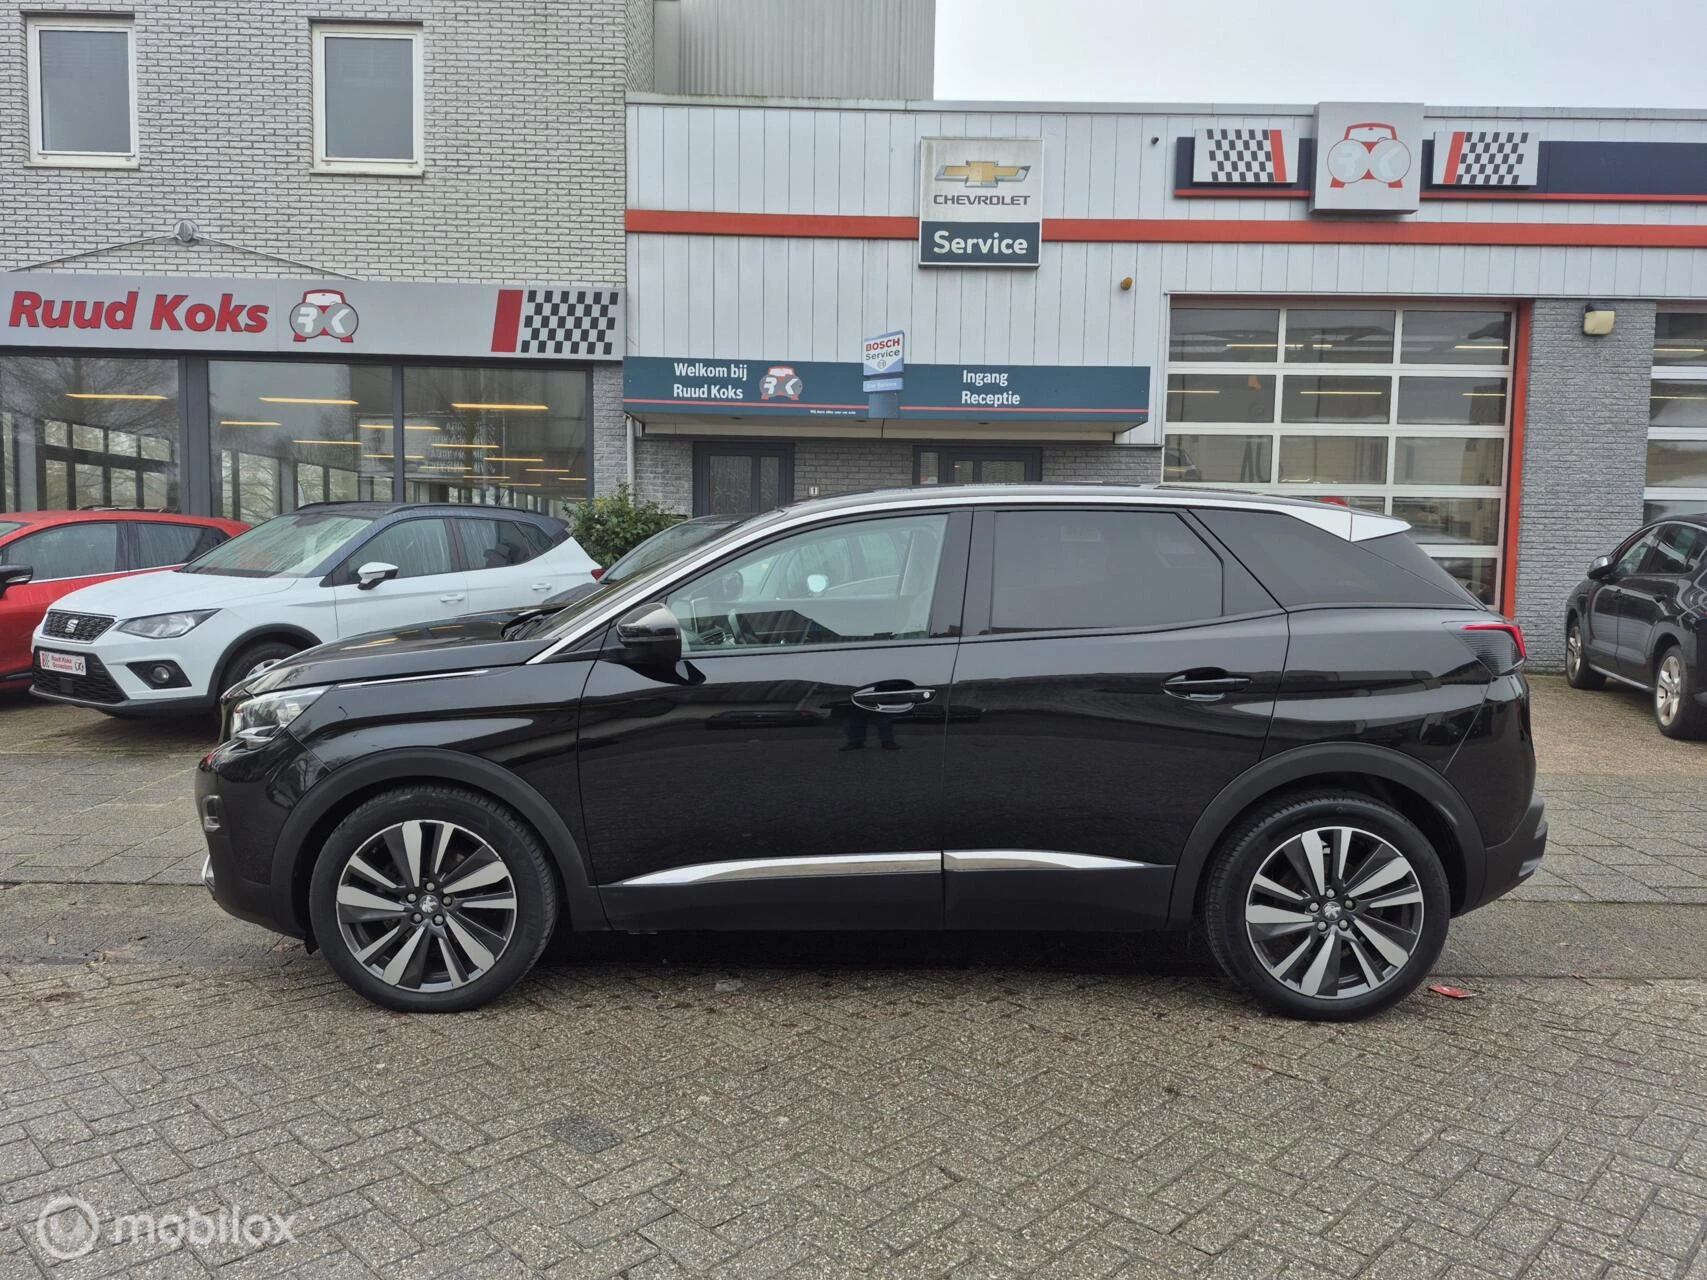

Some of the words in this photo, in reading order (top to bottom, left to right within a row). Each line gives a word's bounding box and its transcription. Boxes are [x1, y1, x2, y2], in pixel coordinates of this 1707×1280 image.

[933, 194, 1031, 206] CHEVROLET
[933, 230, 1028, 254] Service
[8, 290, 140, 330] Ruud
[149, 293, 270, 333] Koks
[865, 338, 901, 352] BOSCH
[865, 349, 901, 361] Service
[674, 362, 728, 378] Welkom
[730, 363, 748, 381] bij
[962, 369, 1009, 387] Ingang
[673, 383, 708, 398] Ruud
[710, 385, 744, 399] Koks
[961, 390, 1021, 408] Receptie
